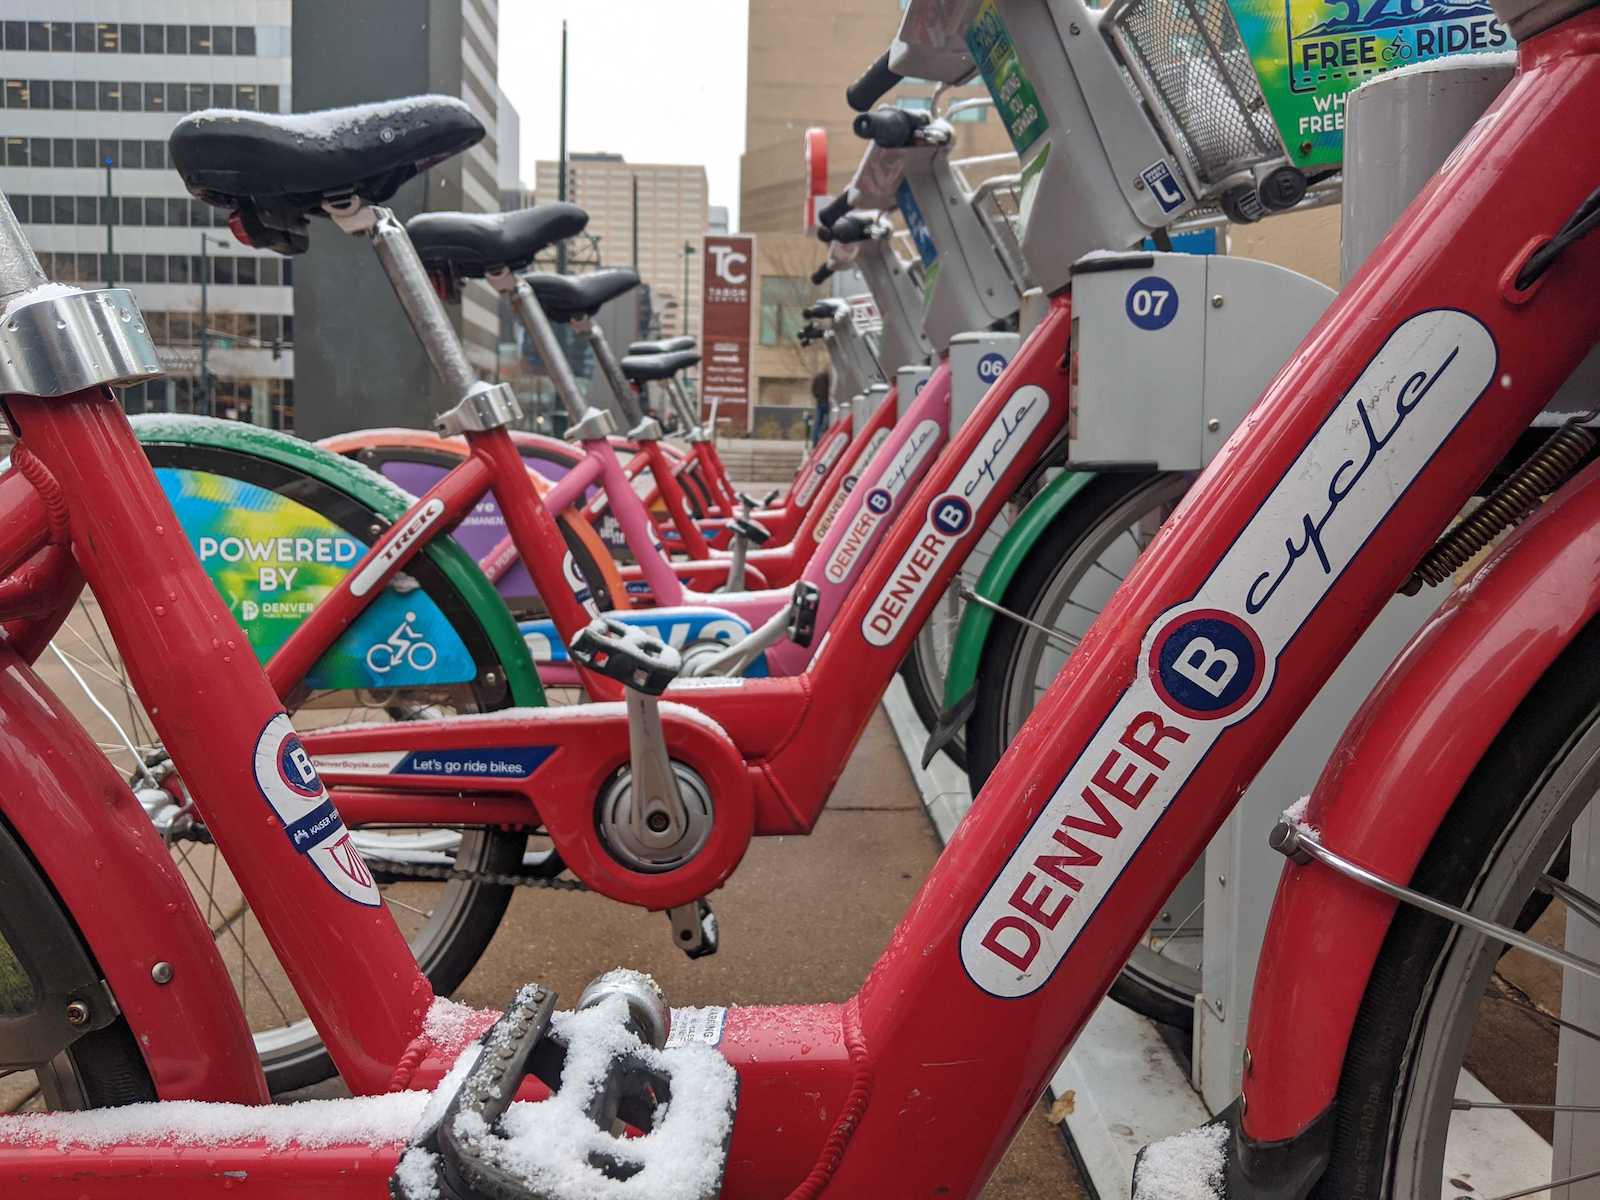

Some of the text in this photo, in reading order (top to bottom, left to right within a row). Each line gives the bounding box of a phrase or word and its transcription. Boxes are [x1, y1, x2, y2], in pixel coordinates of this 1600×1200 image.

[1303, 19, 1508, 71] FREE RIDES
[708, 245, 747, 284] TC
[1133, 290, 1169, 316] 07
[980, 360, 1003, 377] 06
[870, 397, 1038, 636] DENVER B cycle
[382, 506, 436, 560] TREK
[831, 512, 876, 579] DENVER
[870, 494, 888, 511] B
[199, 537, 357, 563] POWERED
[259, 567, 298, 592] BY
[262, 603, 314, 613] DENVER
[981, 345, 1460, 972] DENVER B cycle
[289, 747, 318, 784] B
[413, 758, 442, 771] Let's
[444, 761, 461, 774] go
[463, 759, 487, 772] ride
[489, 760, 526, 774] bikes.
[309, 816, 331, 835] KAISER
